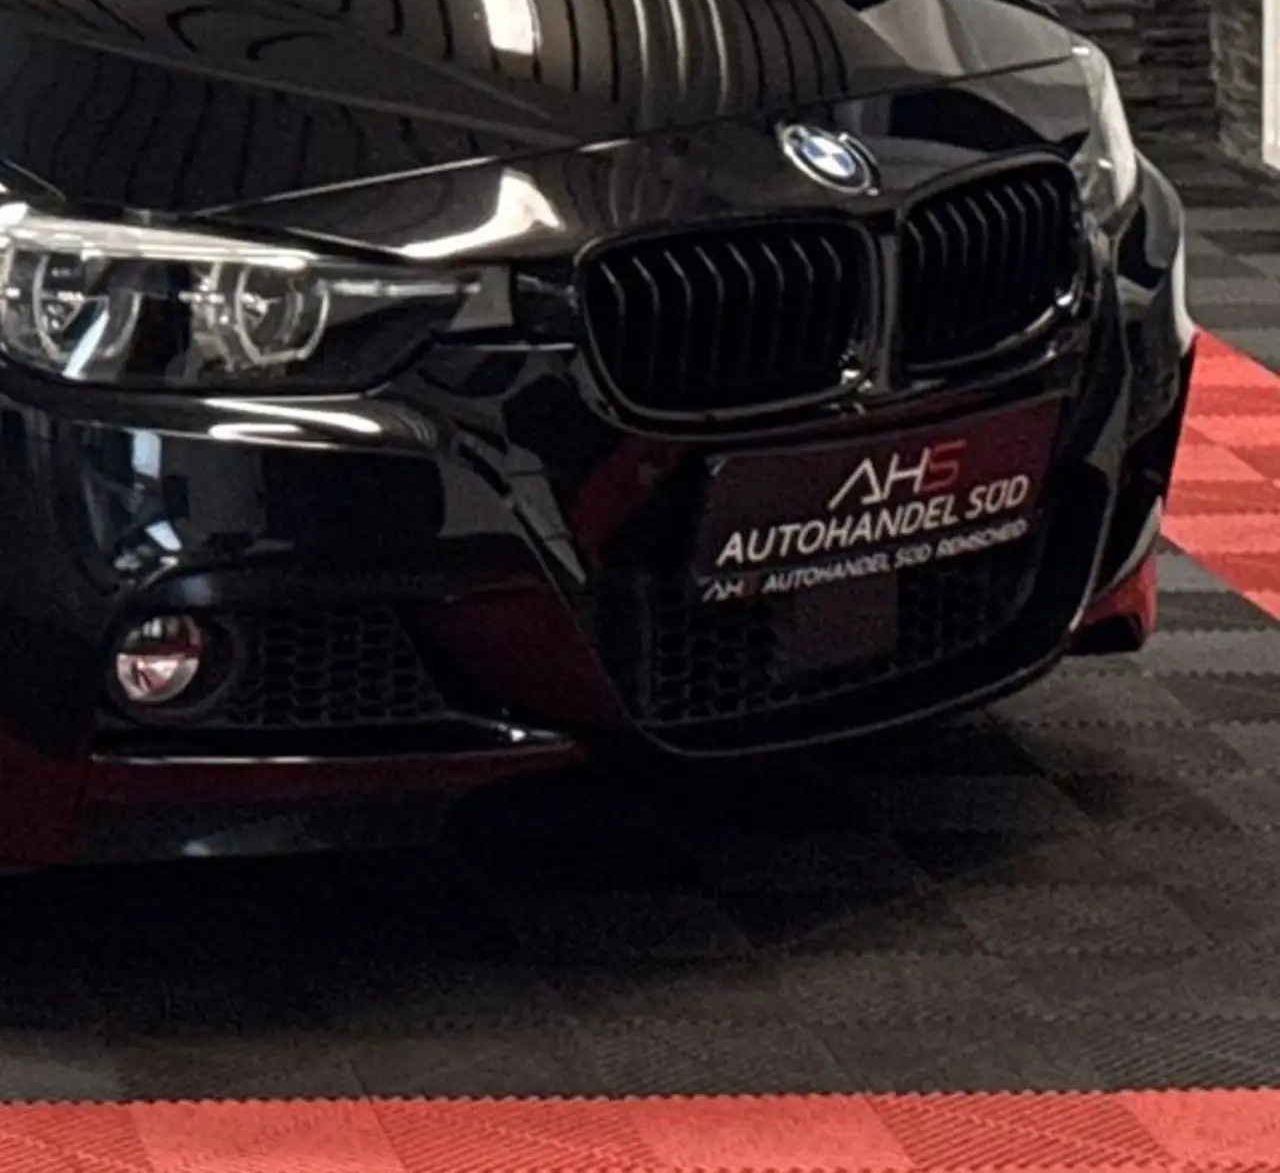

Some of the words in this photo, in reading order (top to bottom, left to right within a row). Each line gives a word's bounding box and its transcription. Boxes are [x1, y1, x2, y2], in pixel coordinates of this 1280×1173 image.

[828, 441, 965, 509] AHS
[715, 496, 959, 568] AUTOHANDEL
[762, 551, 891, 594] AUTOHANDEL
